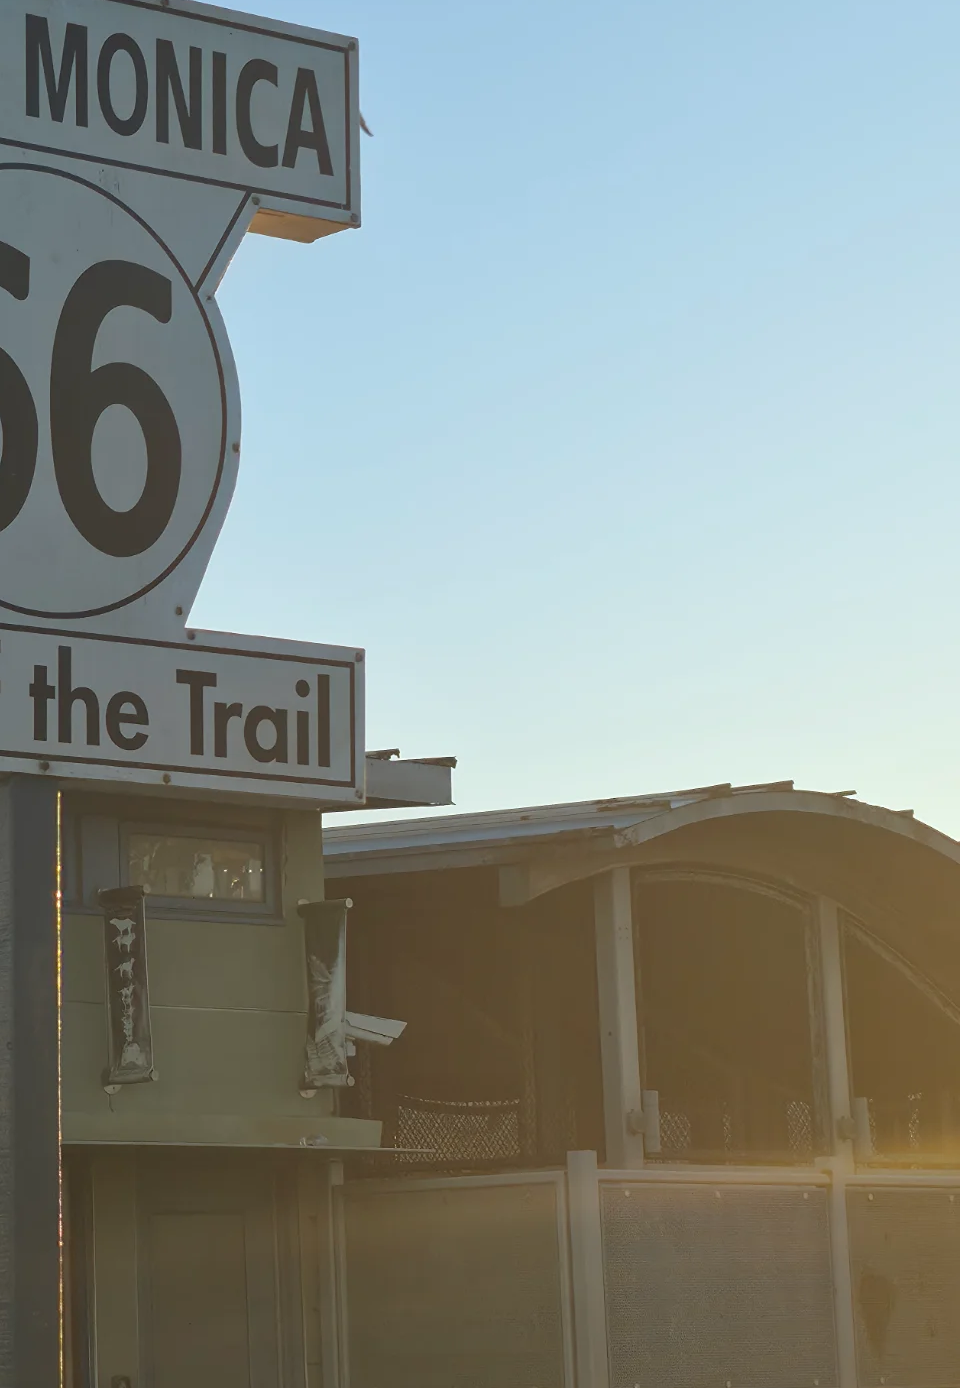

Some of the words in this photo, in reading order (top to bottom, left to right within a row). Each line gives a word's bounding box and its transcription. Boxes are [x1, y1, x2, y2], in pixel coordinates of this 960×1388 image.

[25, 12, 334, 177] MONICA
[28, 645, 150, 751] the
[175, 668, 332, 768] Trail
